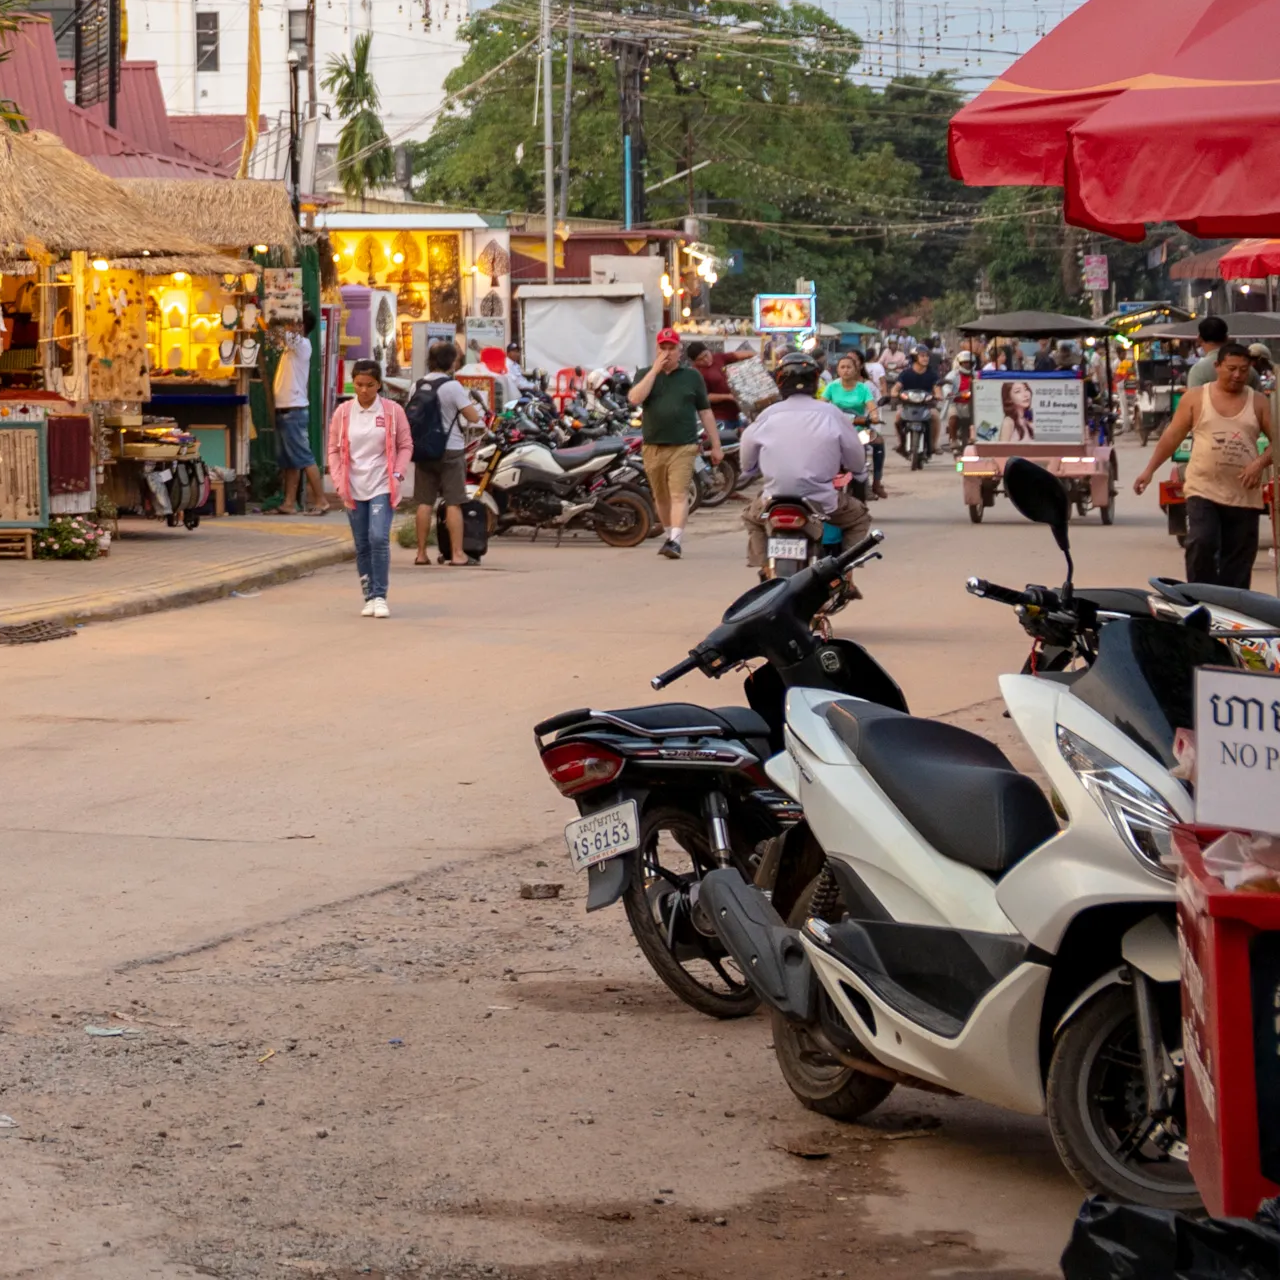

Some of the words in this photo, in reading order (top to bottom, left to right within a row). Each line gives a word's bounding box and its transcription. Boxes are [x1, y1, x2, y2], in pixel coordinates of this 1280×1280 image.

[1220, 740, 1258, 769] NO
[1265, 746, 1280, 771] P
[573, 822, 630, 862] 1S-6153
